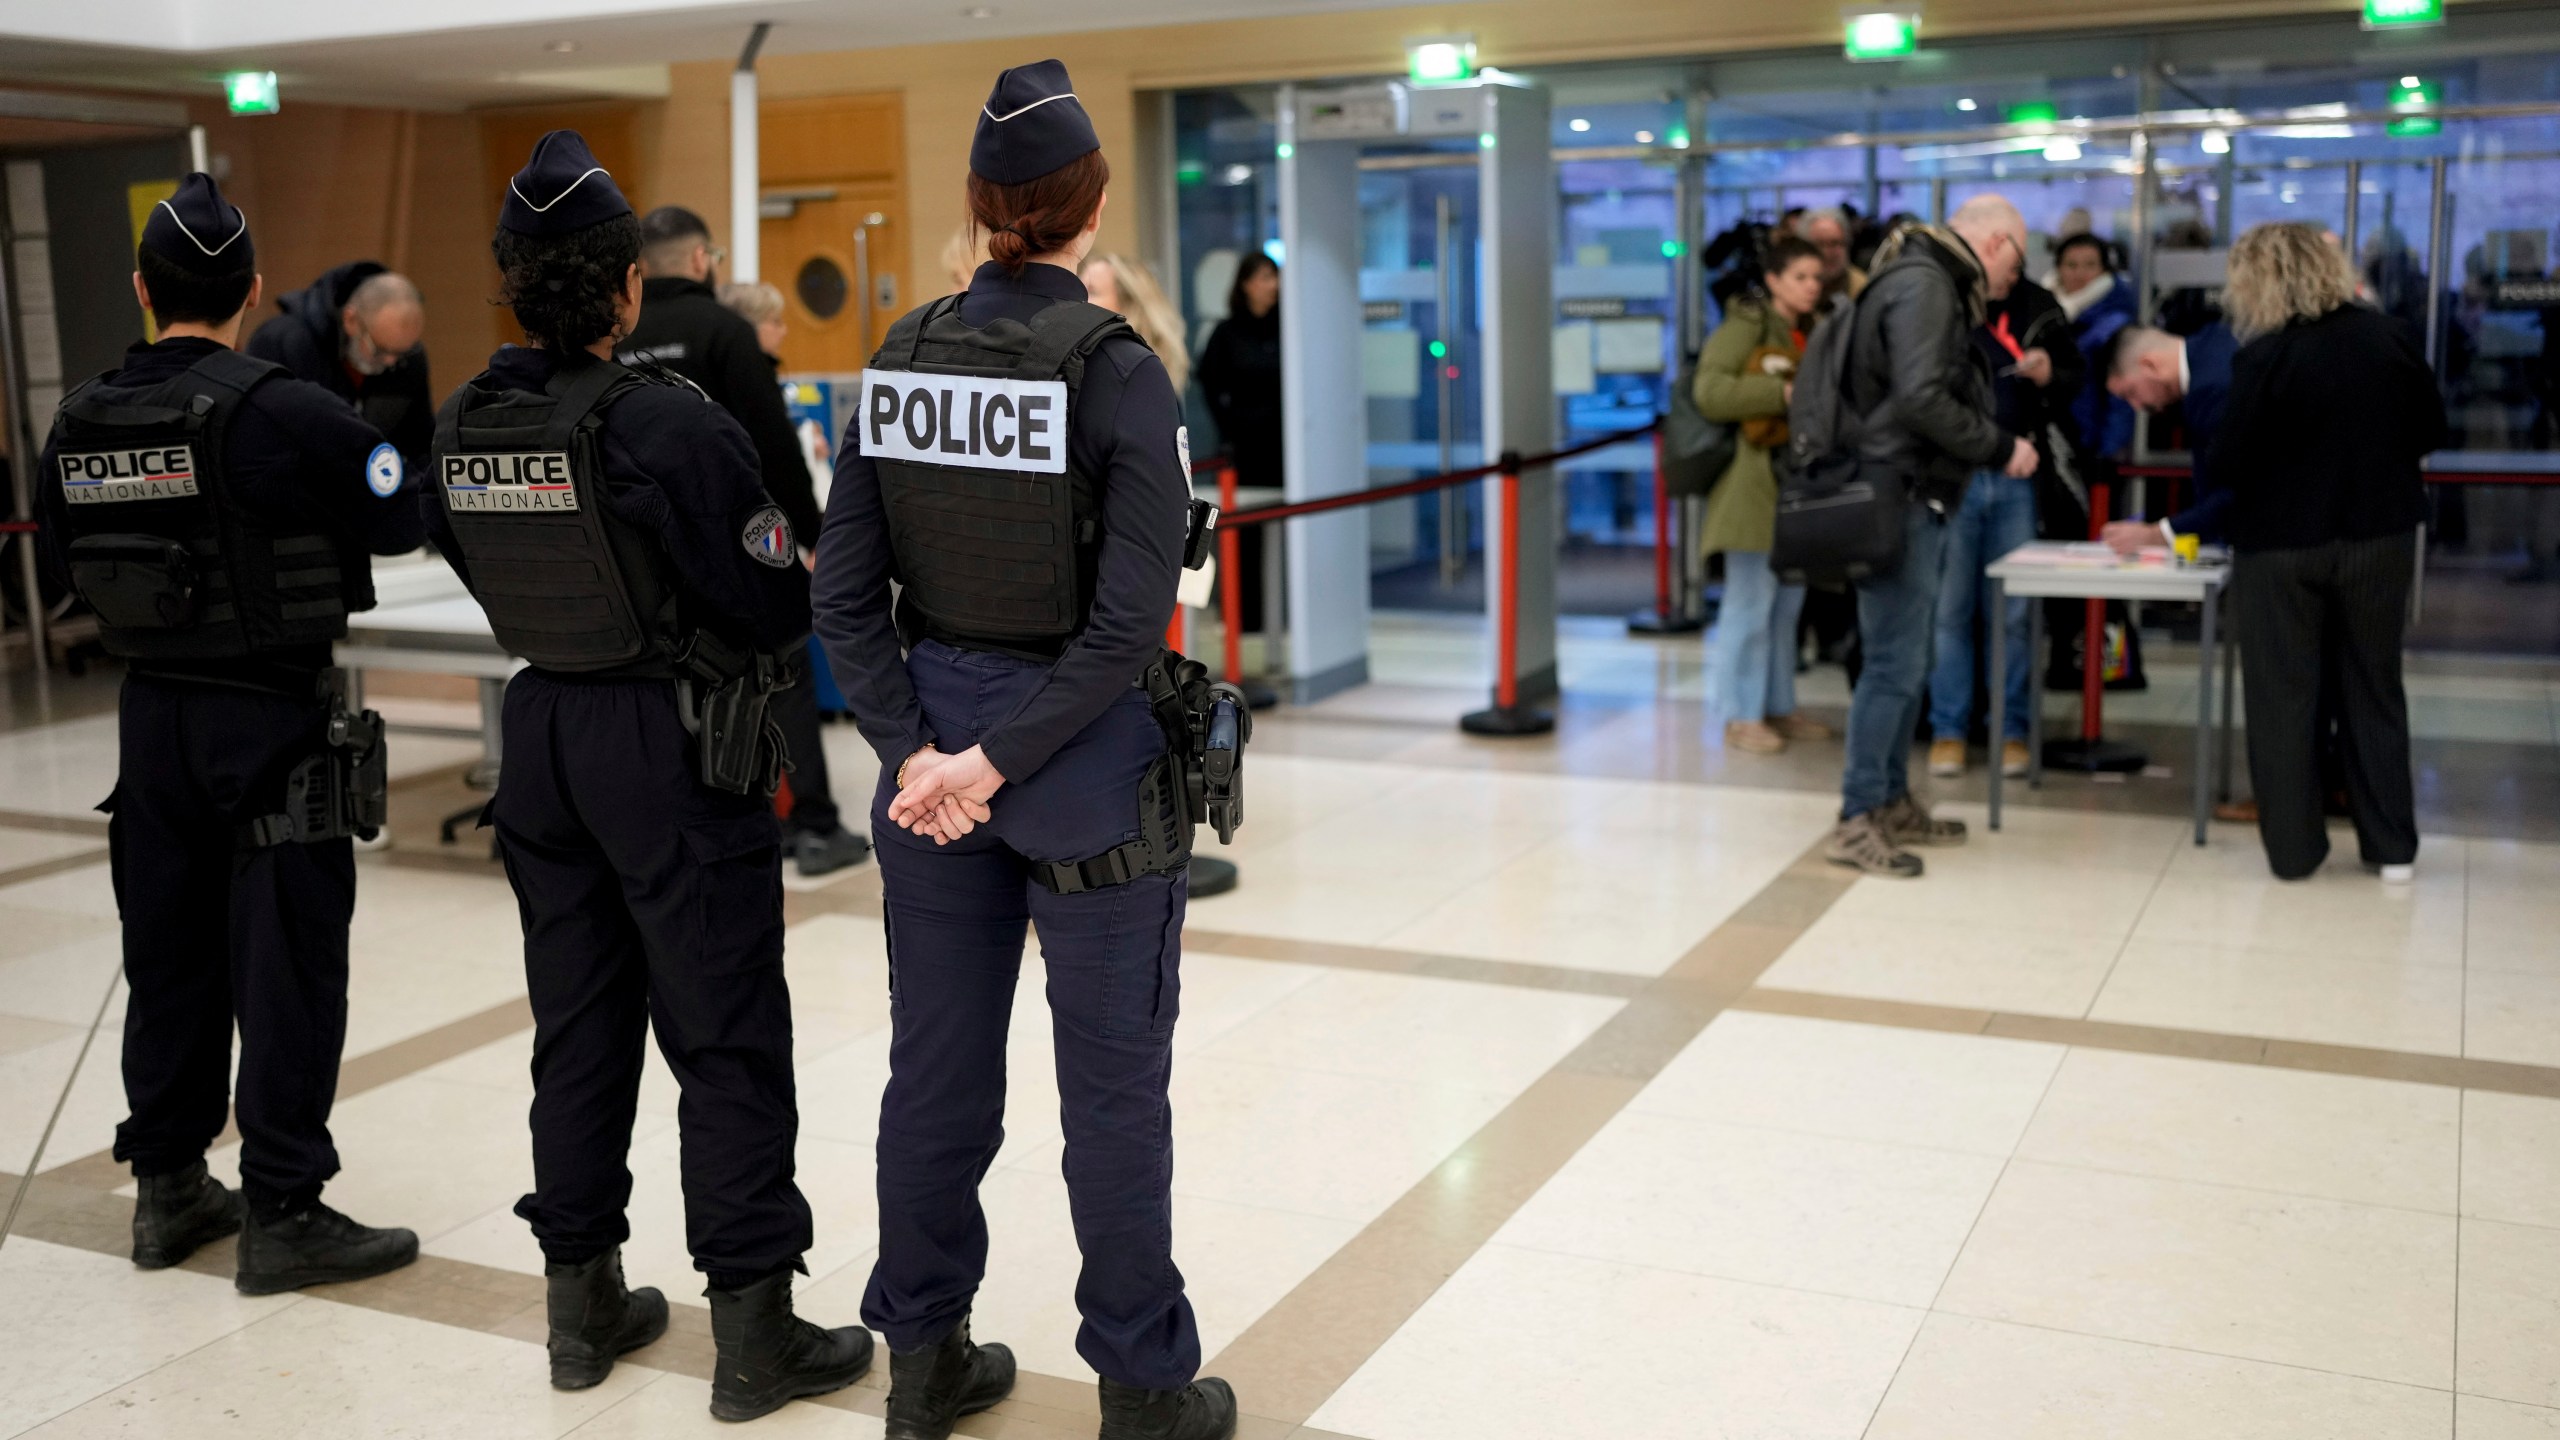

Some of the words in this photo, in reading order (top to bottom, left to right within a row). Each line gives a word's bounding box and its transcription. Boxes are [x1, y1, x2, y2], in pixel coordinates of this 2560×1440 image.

[870, 383, 1052, 460] POLICE
[61, 449, 190, 480] POLICE
[445, 456, 568, 485] POLICE
[66, 479, 196, 501] NATIONALE
[451, 492, 575, 509] NATIONALE
[745, 509, 778, 541] POLICE
[750, 516, 782, 546] NATIONALE
